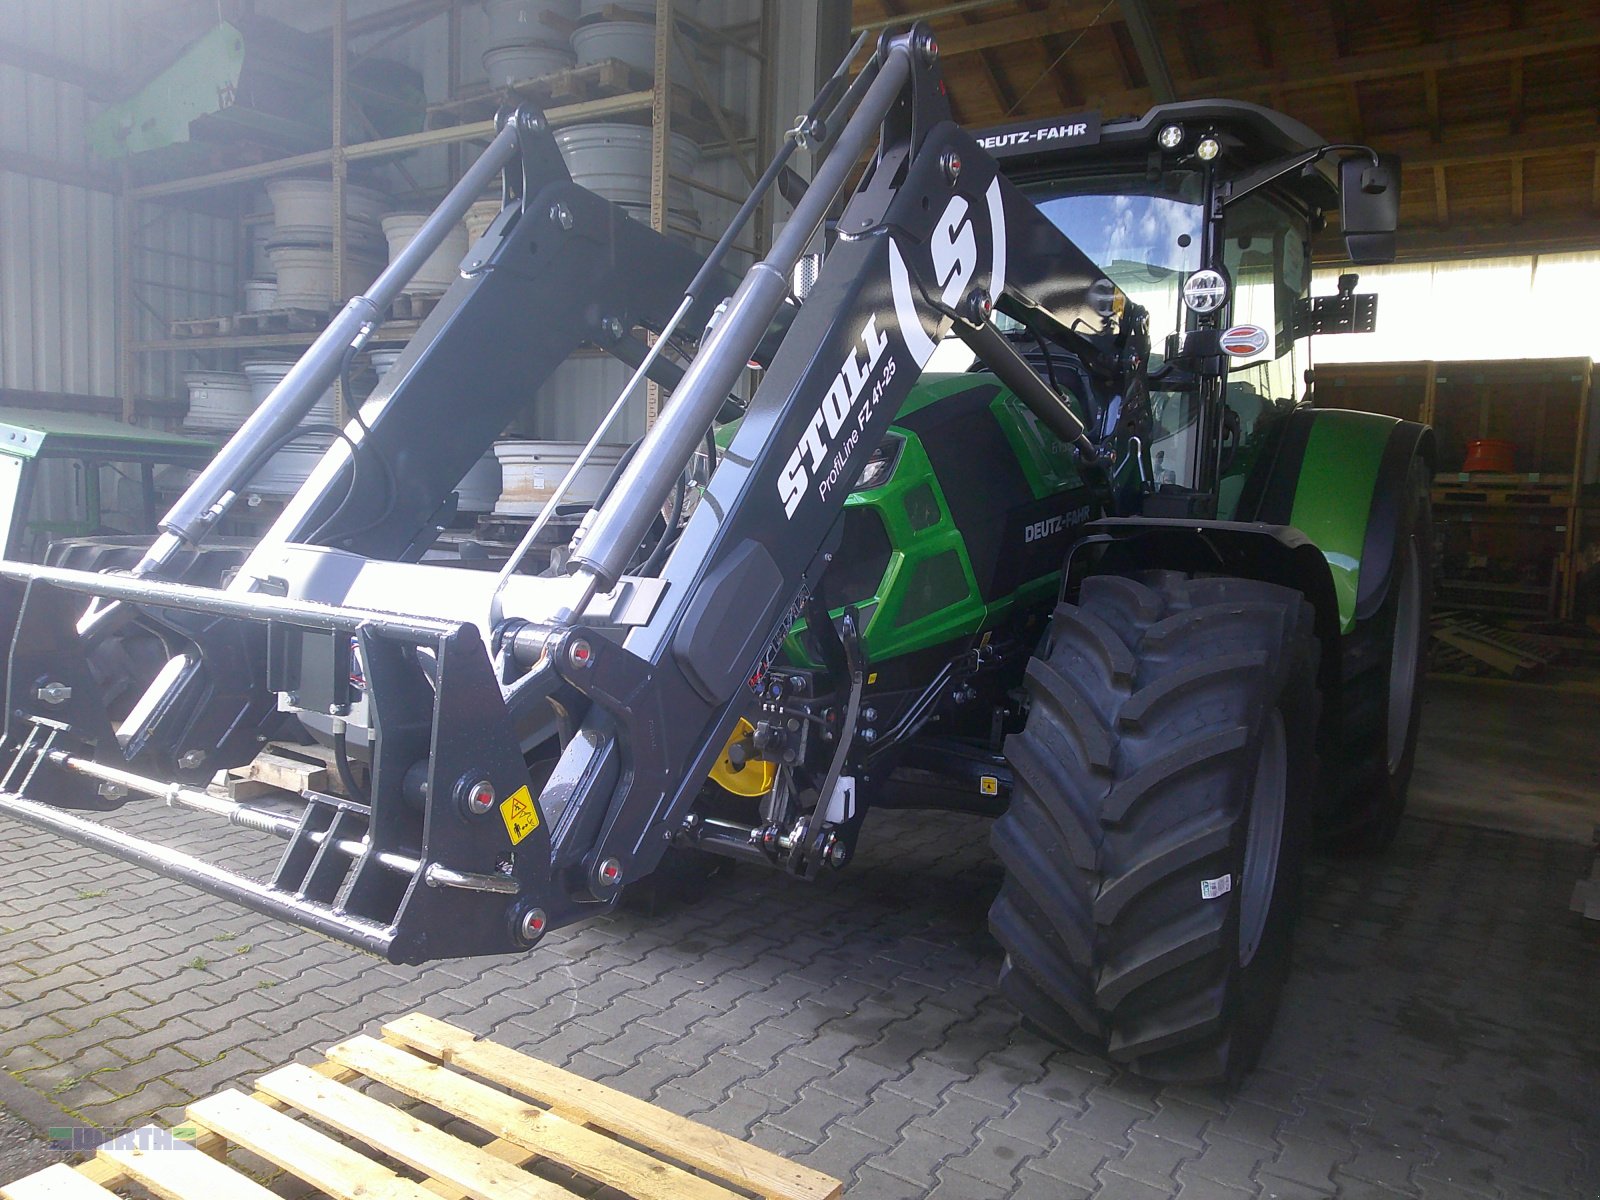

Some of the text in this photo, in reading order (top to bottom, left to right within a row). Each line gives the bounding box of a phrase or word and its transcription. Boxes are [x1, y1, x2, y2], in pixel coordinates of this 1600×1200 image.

[776, 312, 888, 520] STOLL
[818, 356, 896, 502] ProfiLine FZ 41-25
[1025, 505, 1090, 543] DEUTZ-FAHR
